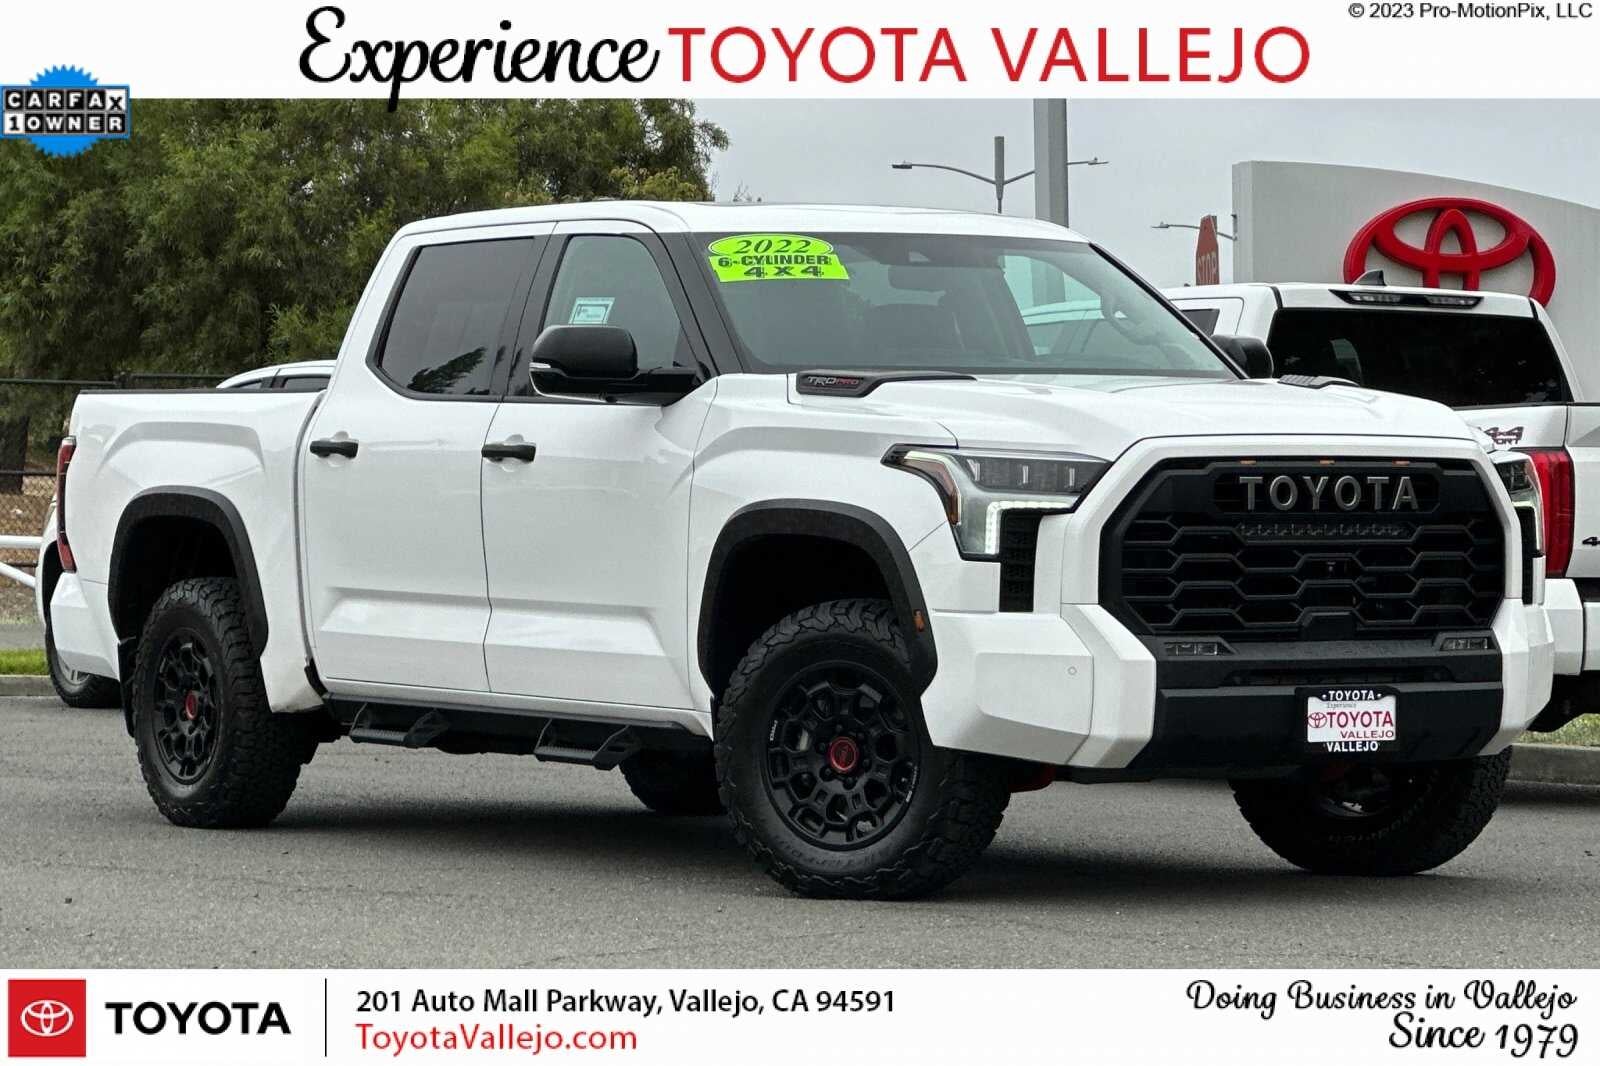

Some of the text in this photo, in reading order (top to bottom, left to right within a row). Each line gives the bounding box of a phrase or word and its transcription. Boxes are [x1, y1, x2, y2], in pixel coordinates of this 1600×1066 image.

[734, 239, 811, 254] 2022
[718, 254, 832, 268] 6-CYLINDER
[1239, 475, 1419, 511] TOYOTA
[1328, 690, 1375, 700] TOYOTA
[1326, 711, 1394, 728] TOYOTA
[1340, 730, 1394, 739] VALLEJO
[1326, 741, 1379, 752] VALLEJO
